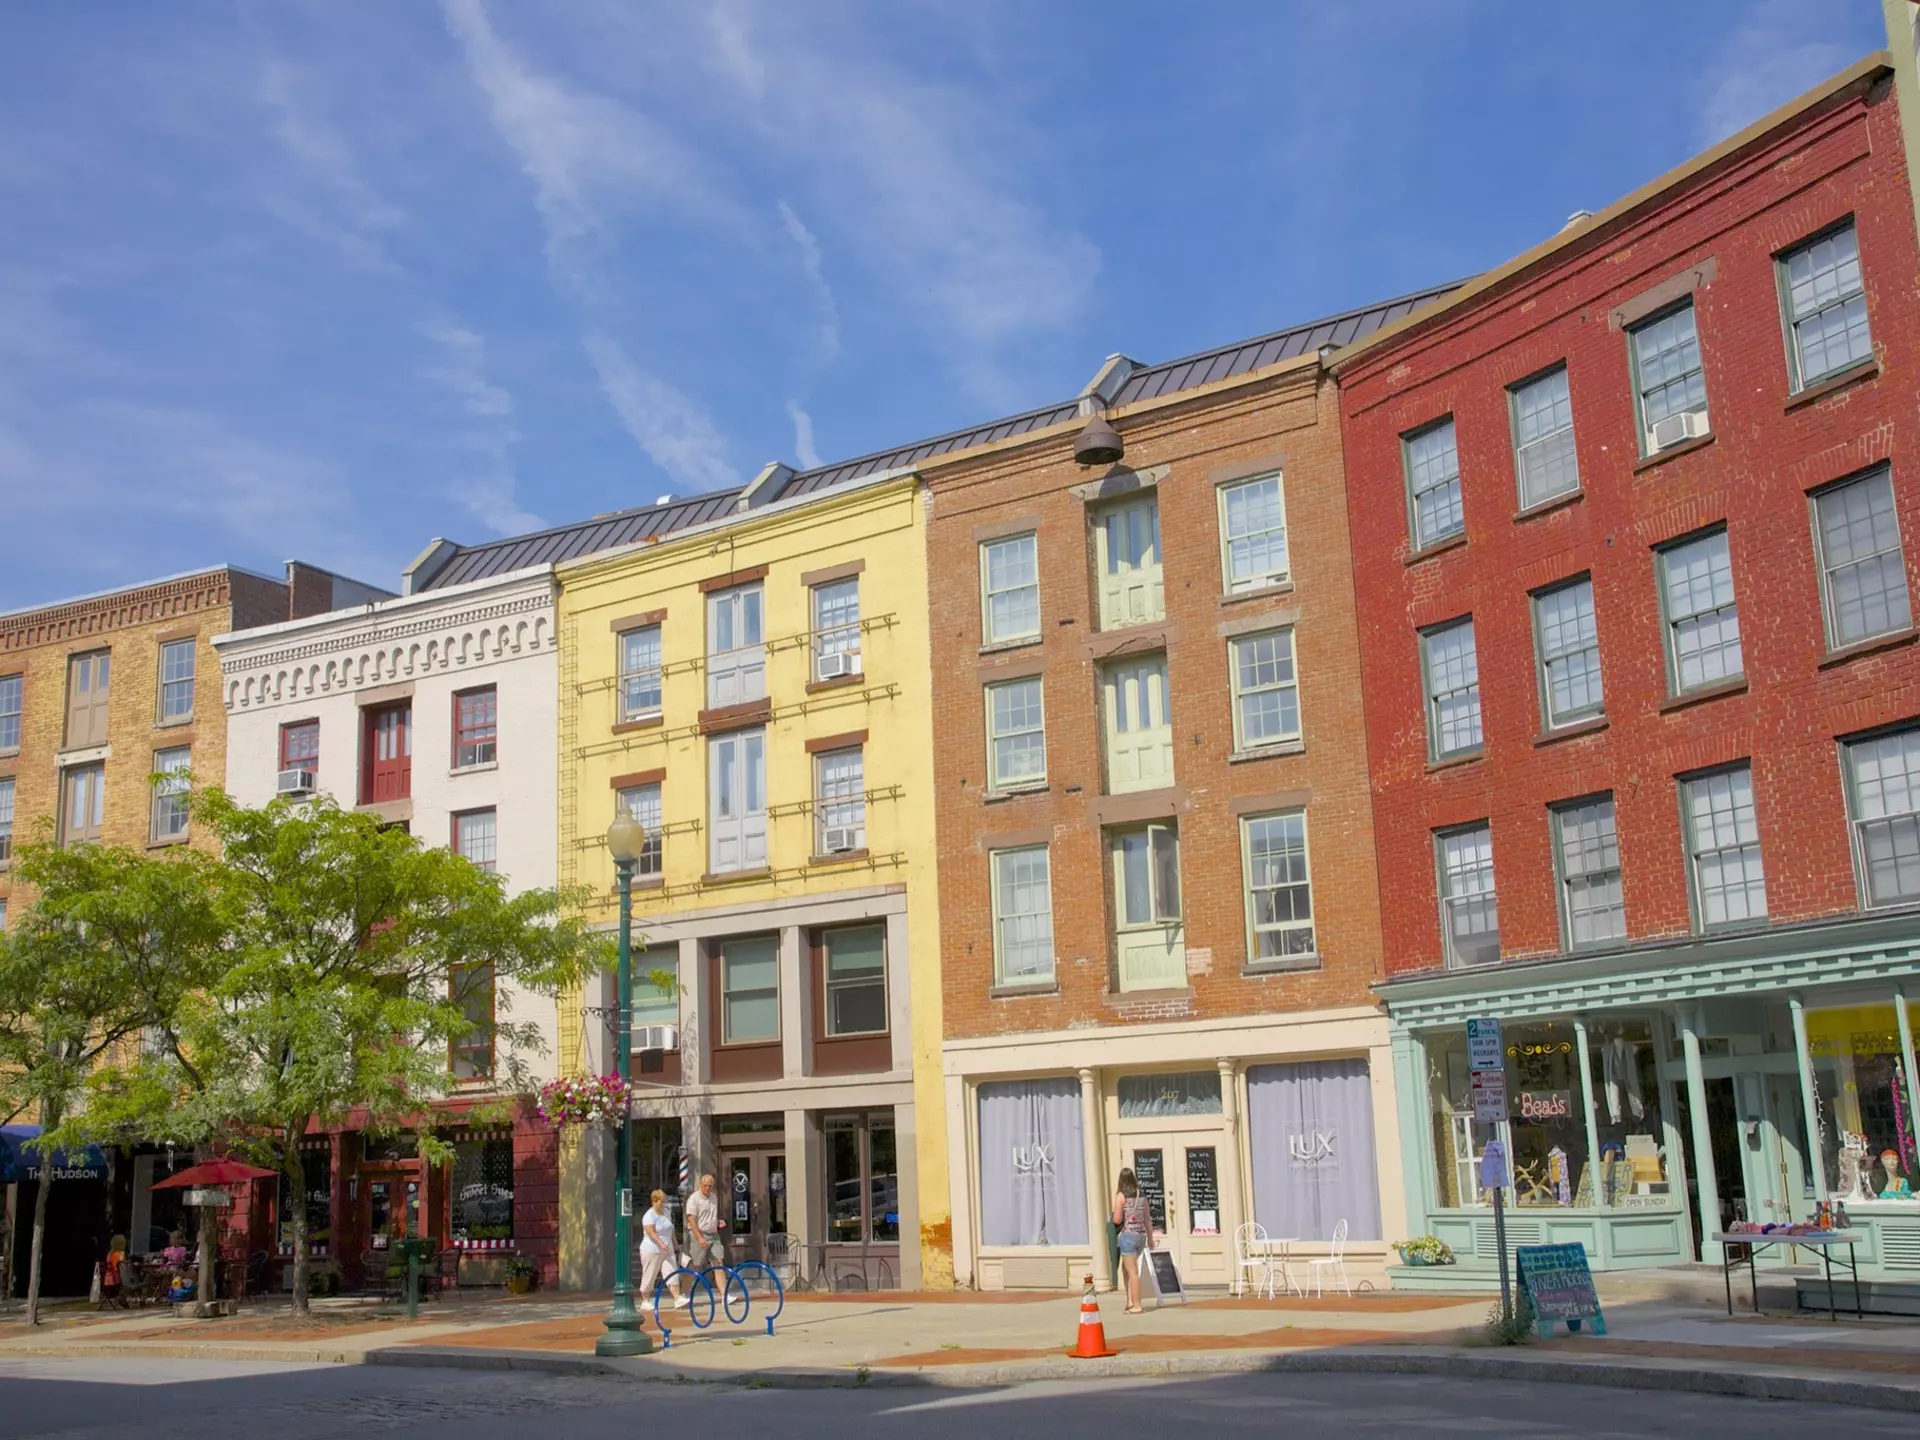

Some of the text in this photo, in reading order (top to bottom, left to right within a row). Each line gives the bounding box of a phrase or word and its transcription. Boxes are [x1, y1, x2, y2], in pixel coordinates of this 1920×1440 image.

[1469, 1022, 1477, 1036] 2
[1472, 1049, 1500, 1057] WEEKDAYS
[1521, 1093, 1566, 1117] Beads
[1290, 1130, 1335, 1159] LUX
[1012, 1142, 1050, 1170] LUX
[51, 1166, 98, 1180] HUDSON
[1625, 1199, 1667, 1208] OPEN SUNDAY
